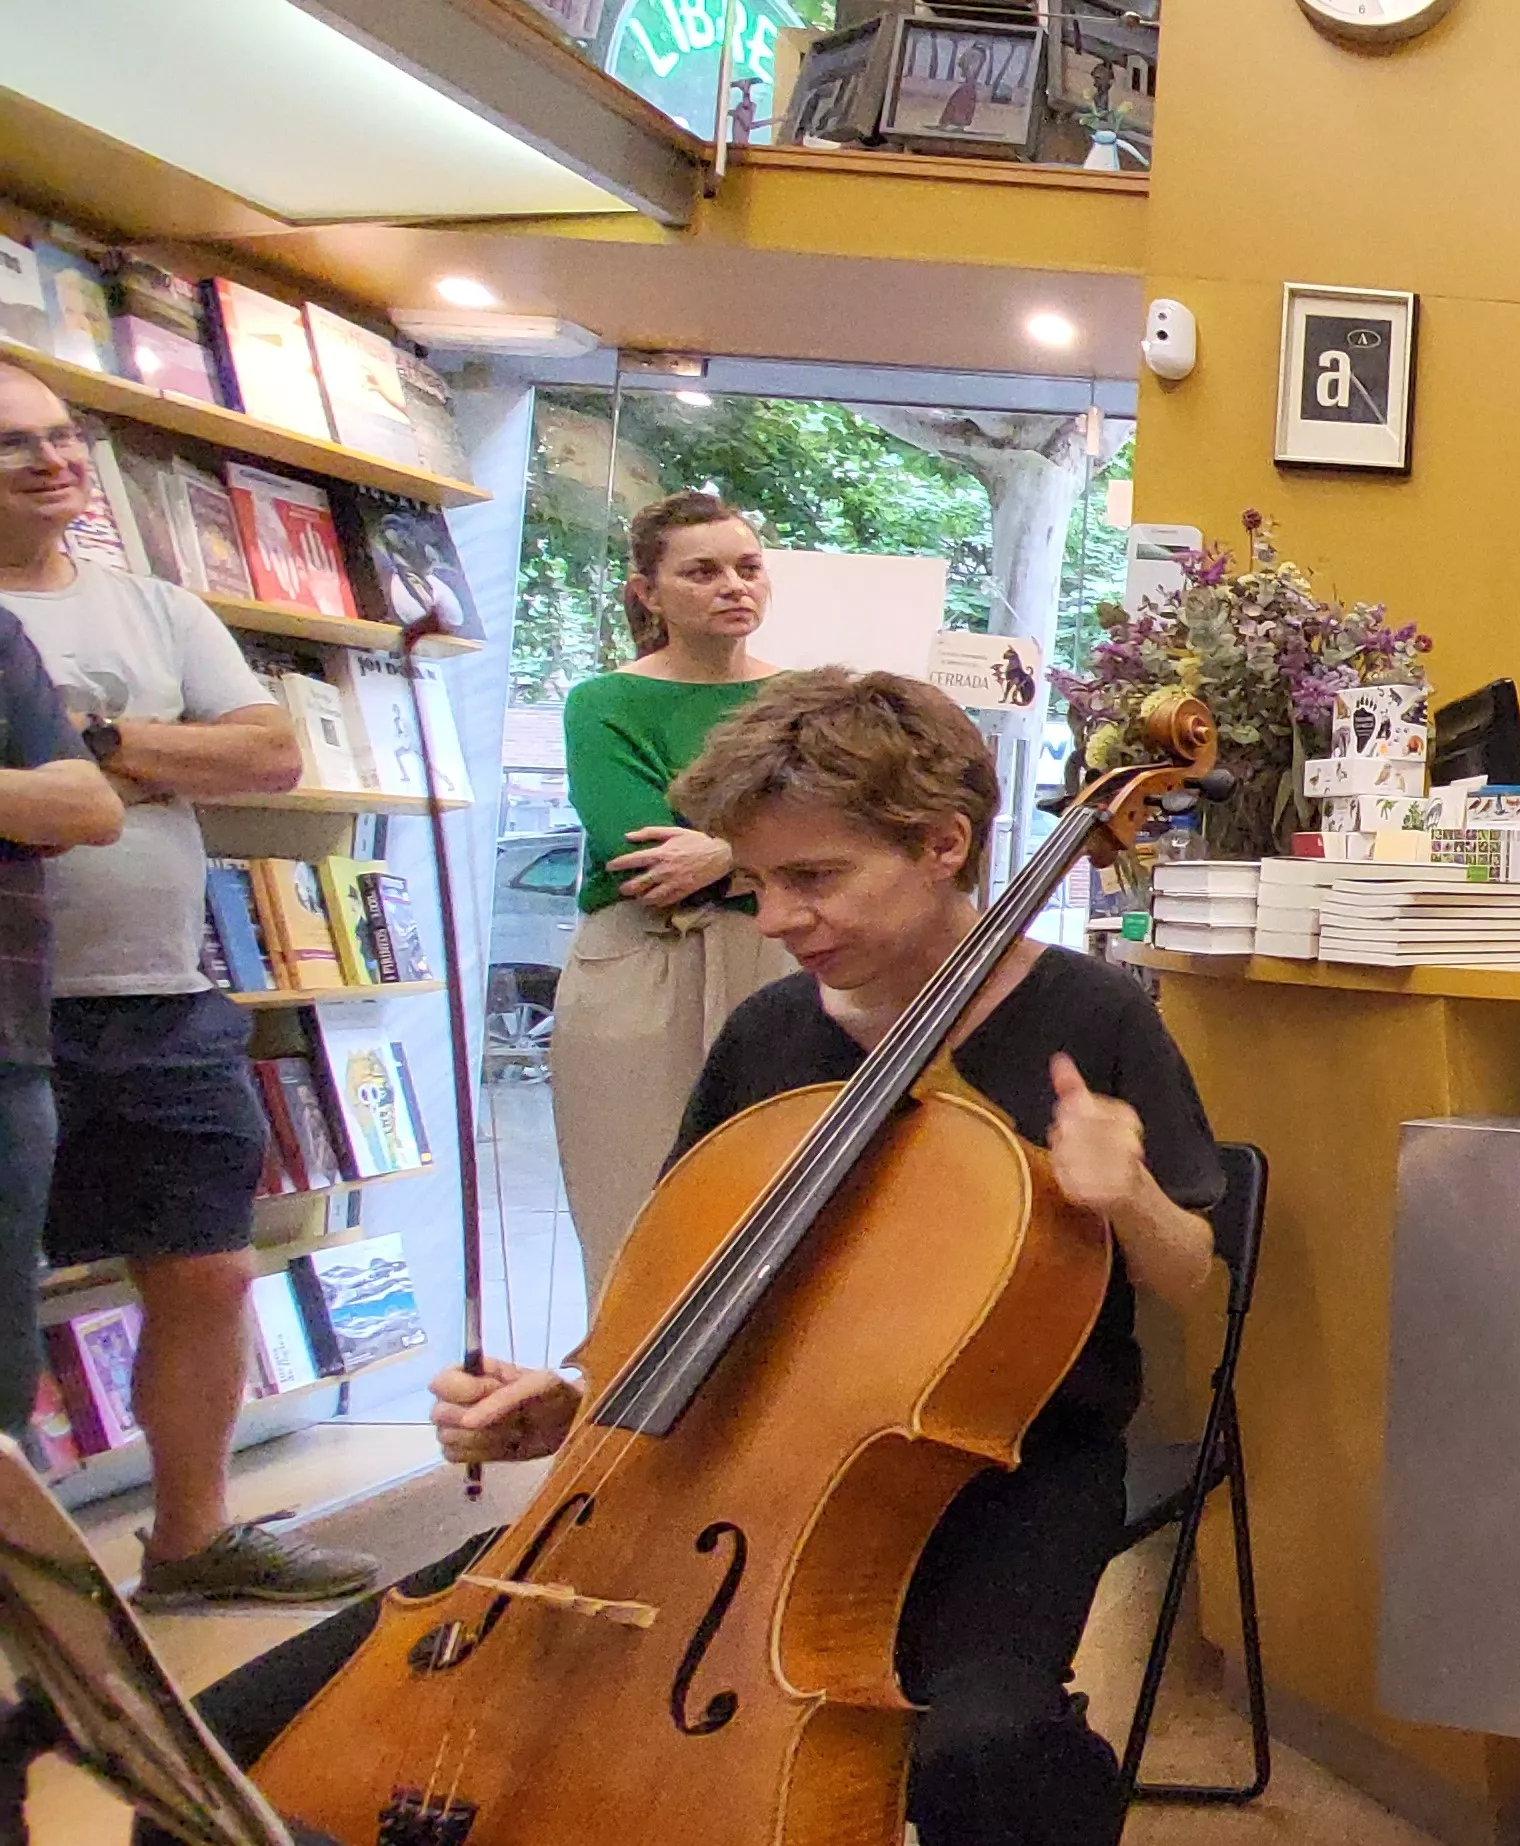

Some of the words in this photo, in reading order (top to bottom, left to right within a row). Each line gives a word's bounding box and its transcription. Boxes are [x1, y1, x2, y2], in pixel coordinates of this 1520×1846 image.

[1358, 4, 1367, 15] 6
[1316, 349, 1351, 408] a
[929, 670, 990, 690] CERRADA
